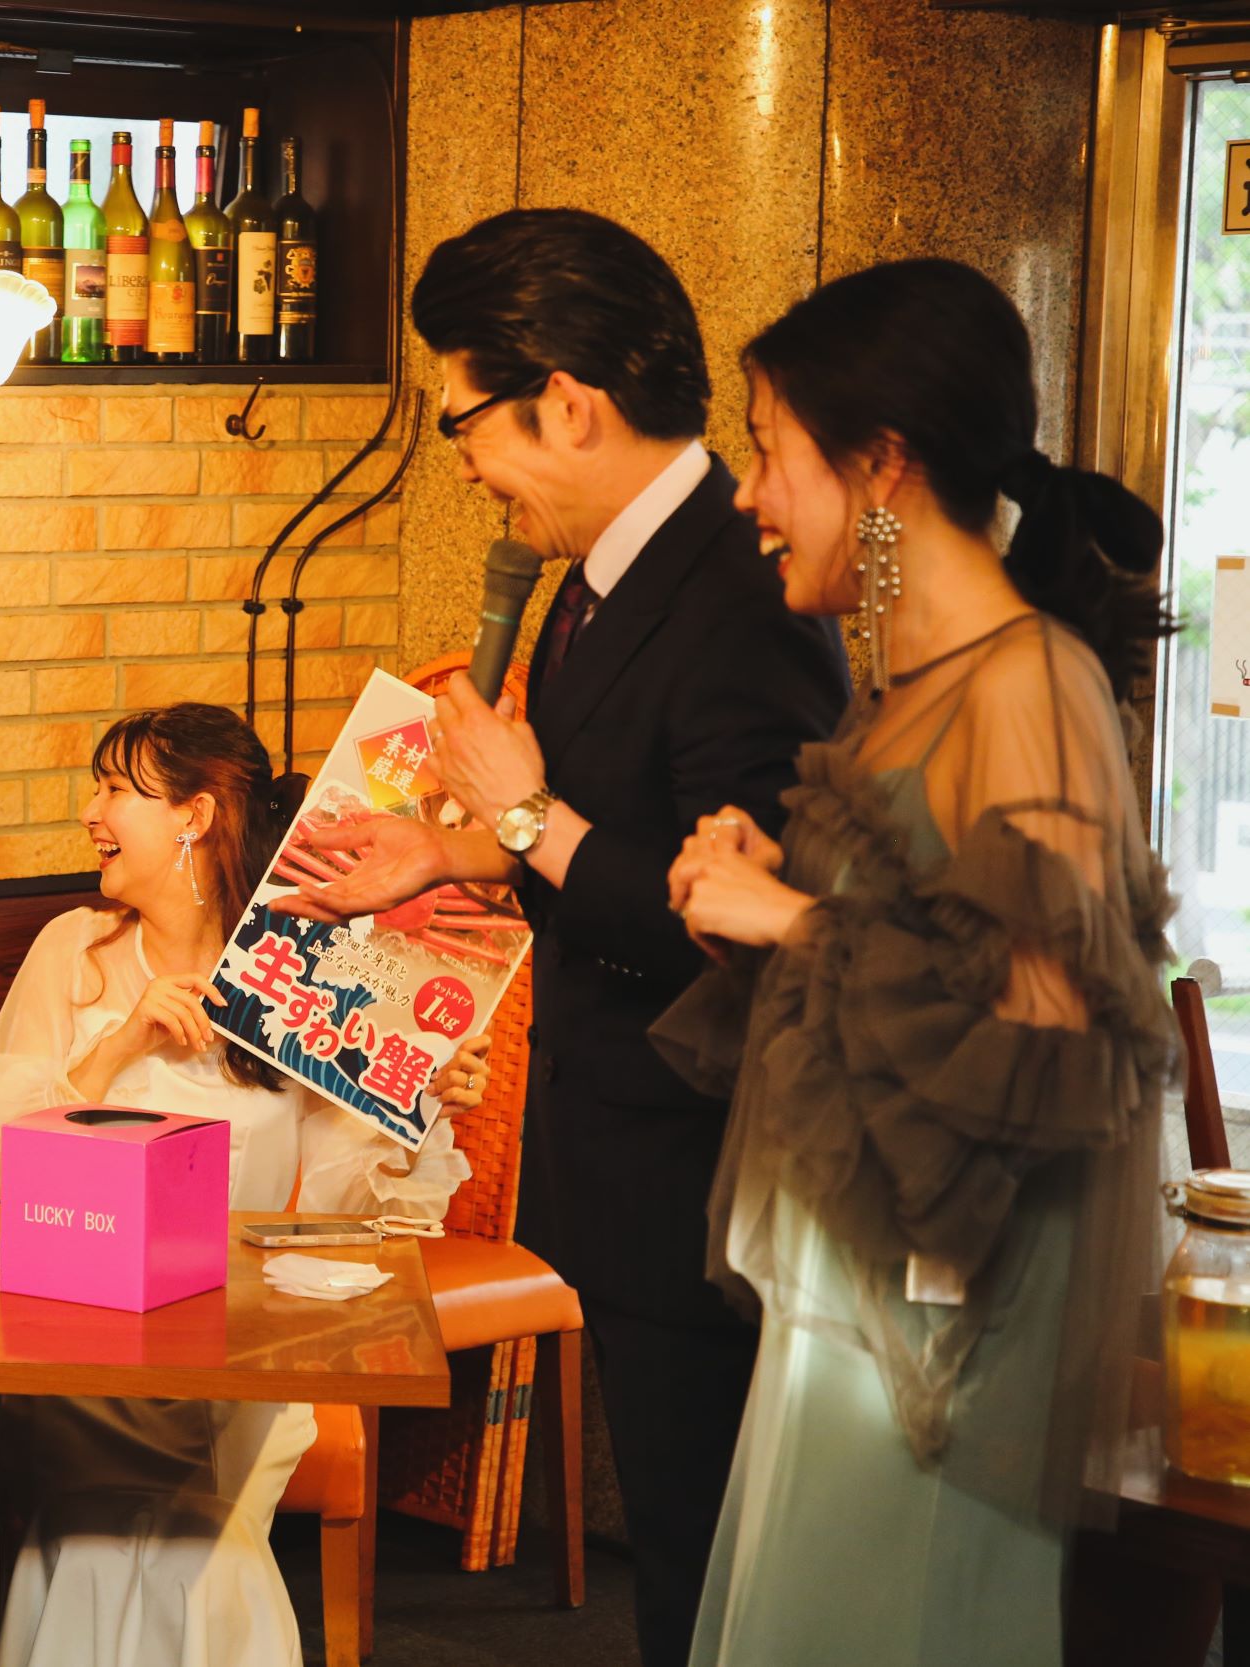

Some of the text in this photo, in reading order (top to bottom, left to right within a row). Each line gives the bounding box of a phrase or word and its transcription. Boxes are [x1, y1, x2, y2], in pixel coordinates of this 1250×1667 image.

[308, 941, 410, 1007] 上品な甘みが魅力
[333, 928, 407, 980] 繊細な身質と
[239, 935, 435, 1109] 生ずわい蟹
[24, 1202, 116, 1234] LUCKY BOX
